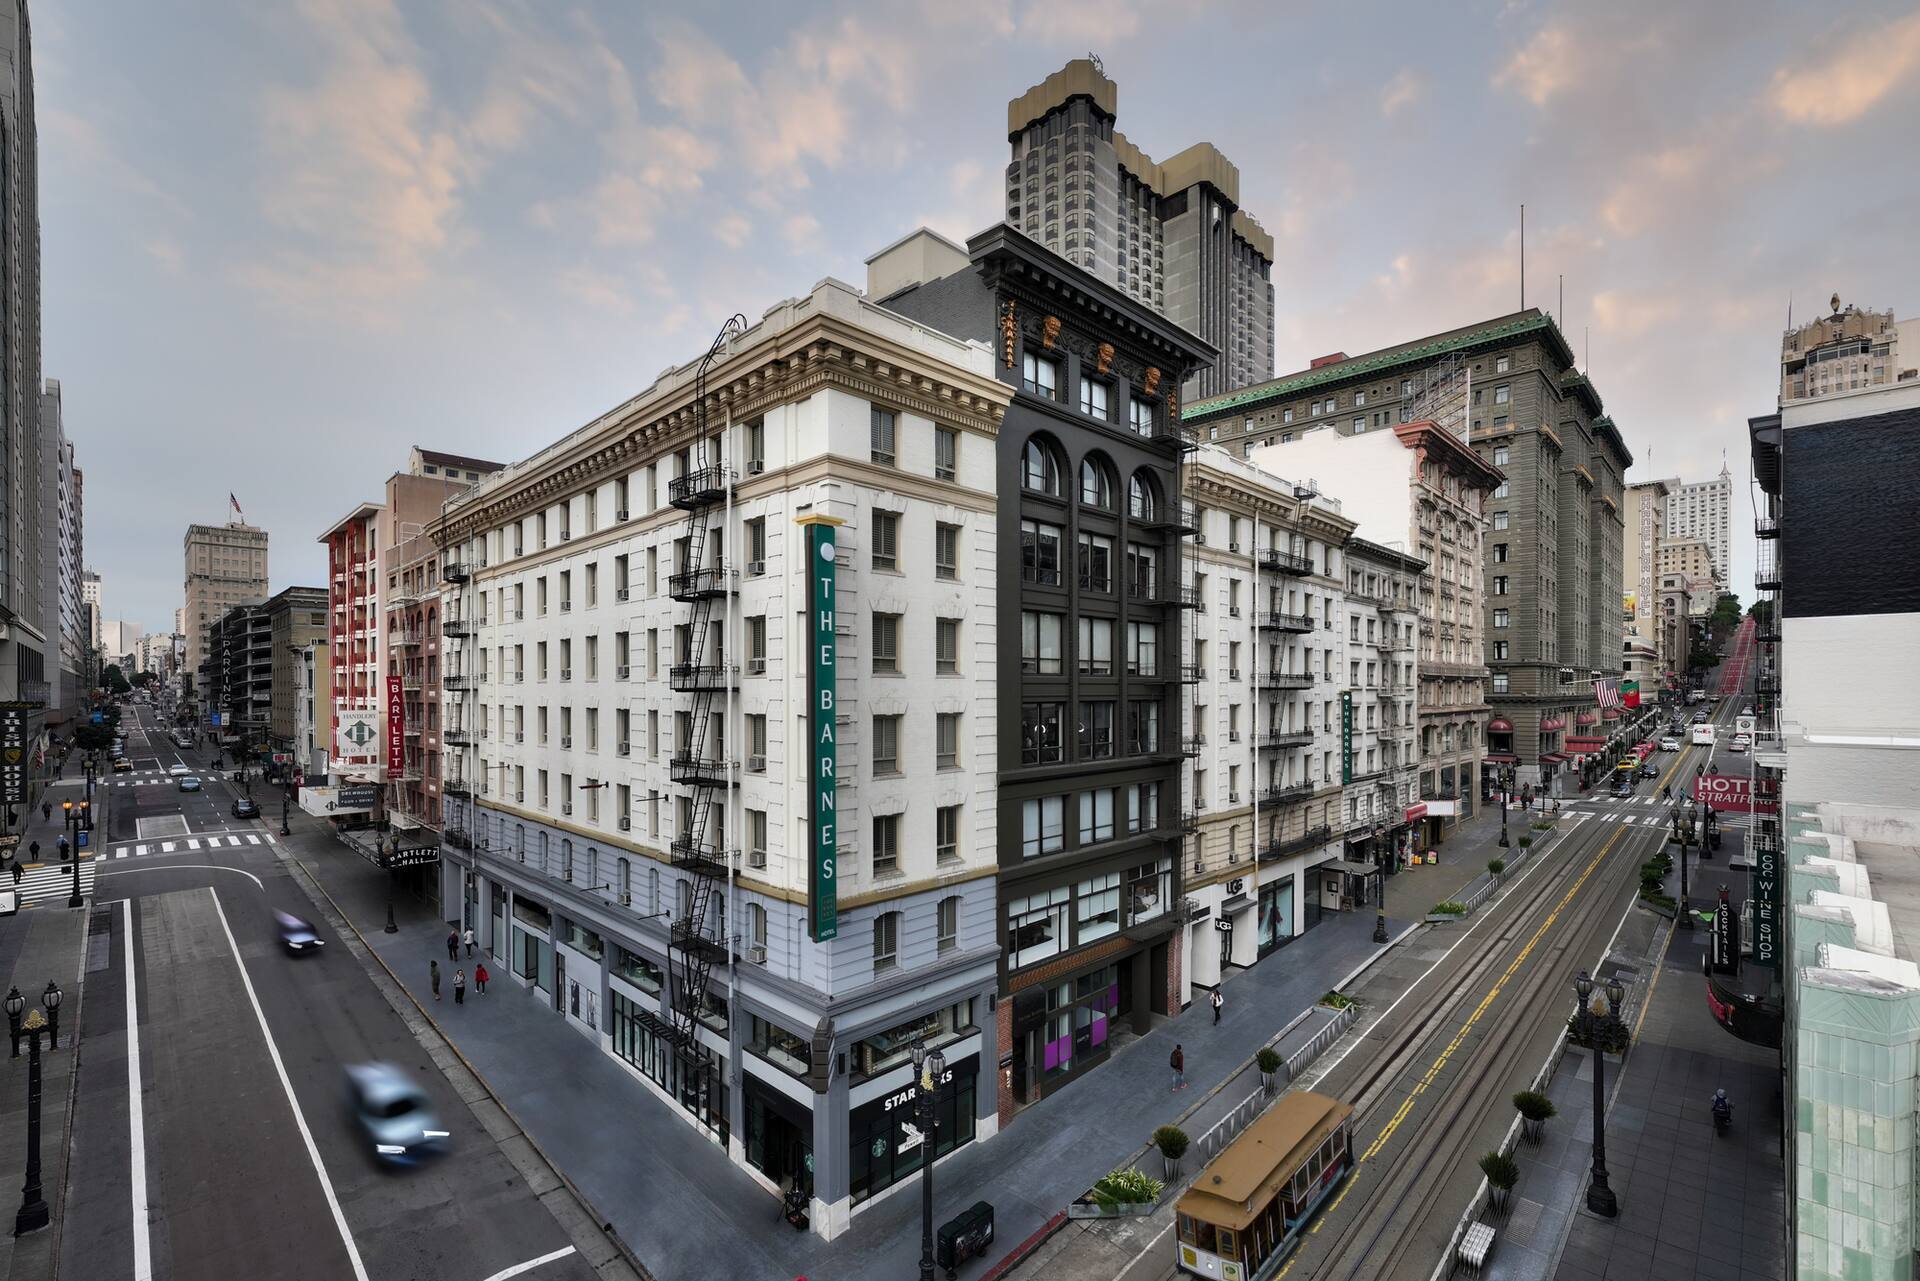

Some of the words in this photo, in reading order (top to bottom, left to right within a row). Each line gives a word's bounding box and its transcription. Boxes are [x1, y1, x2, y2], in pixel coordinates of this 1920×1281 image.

[1641, 577, 1650, 617] HOTEL
[821, 577, 832, 665] THE
[223, 640, 231, 701] PARKING
[3, 711, 21, 747] IRISH
[391, 685, 400, 767] BARTLETT
[342, 746, 377, 754] HOTEL
[4, 765, 21, 801] HOUSE
[821, 690, 833, 879] BARNES
[1698, 778, 1772, 794] HOTEL
[402, 857, 423, 866] HALL
[1226, 879, 1243, 895] UGG
[1760, 881, 1773, 919] WINE
[1215, 920, 1232, 930] UGG
[1721, 903, 1729, 965] COCKTAILS
[1759, 923, 1773, 960] SHOP
[884, 1070, 953, 1111] STARKS
